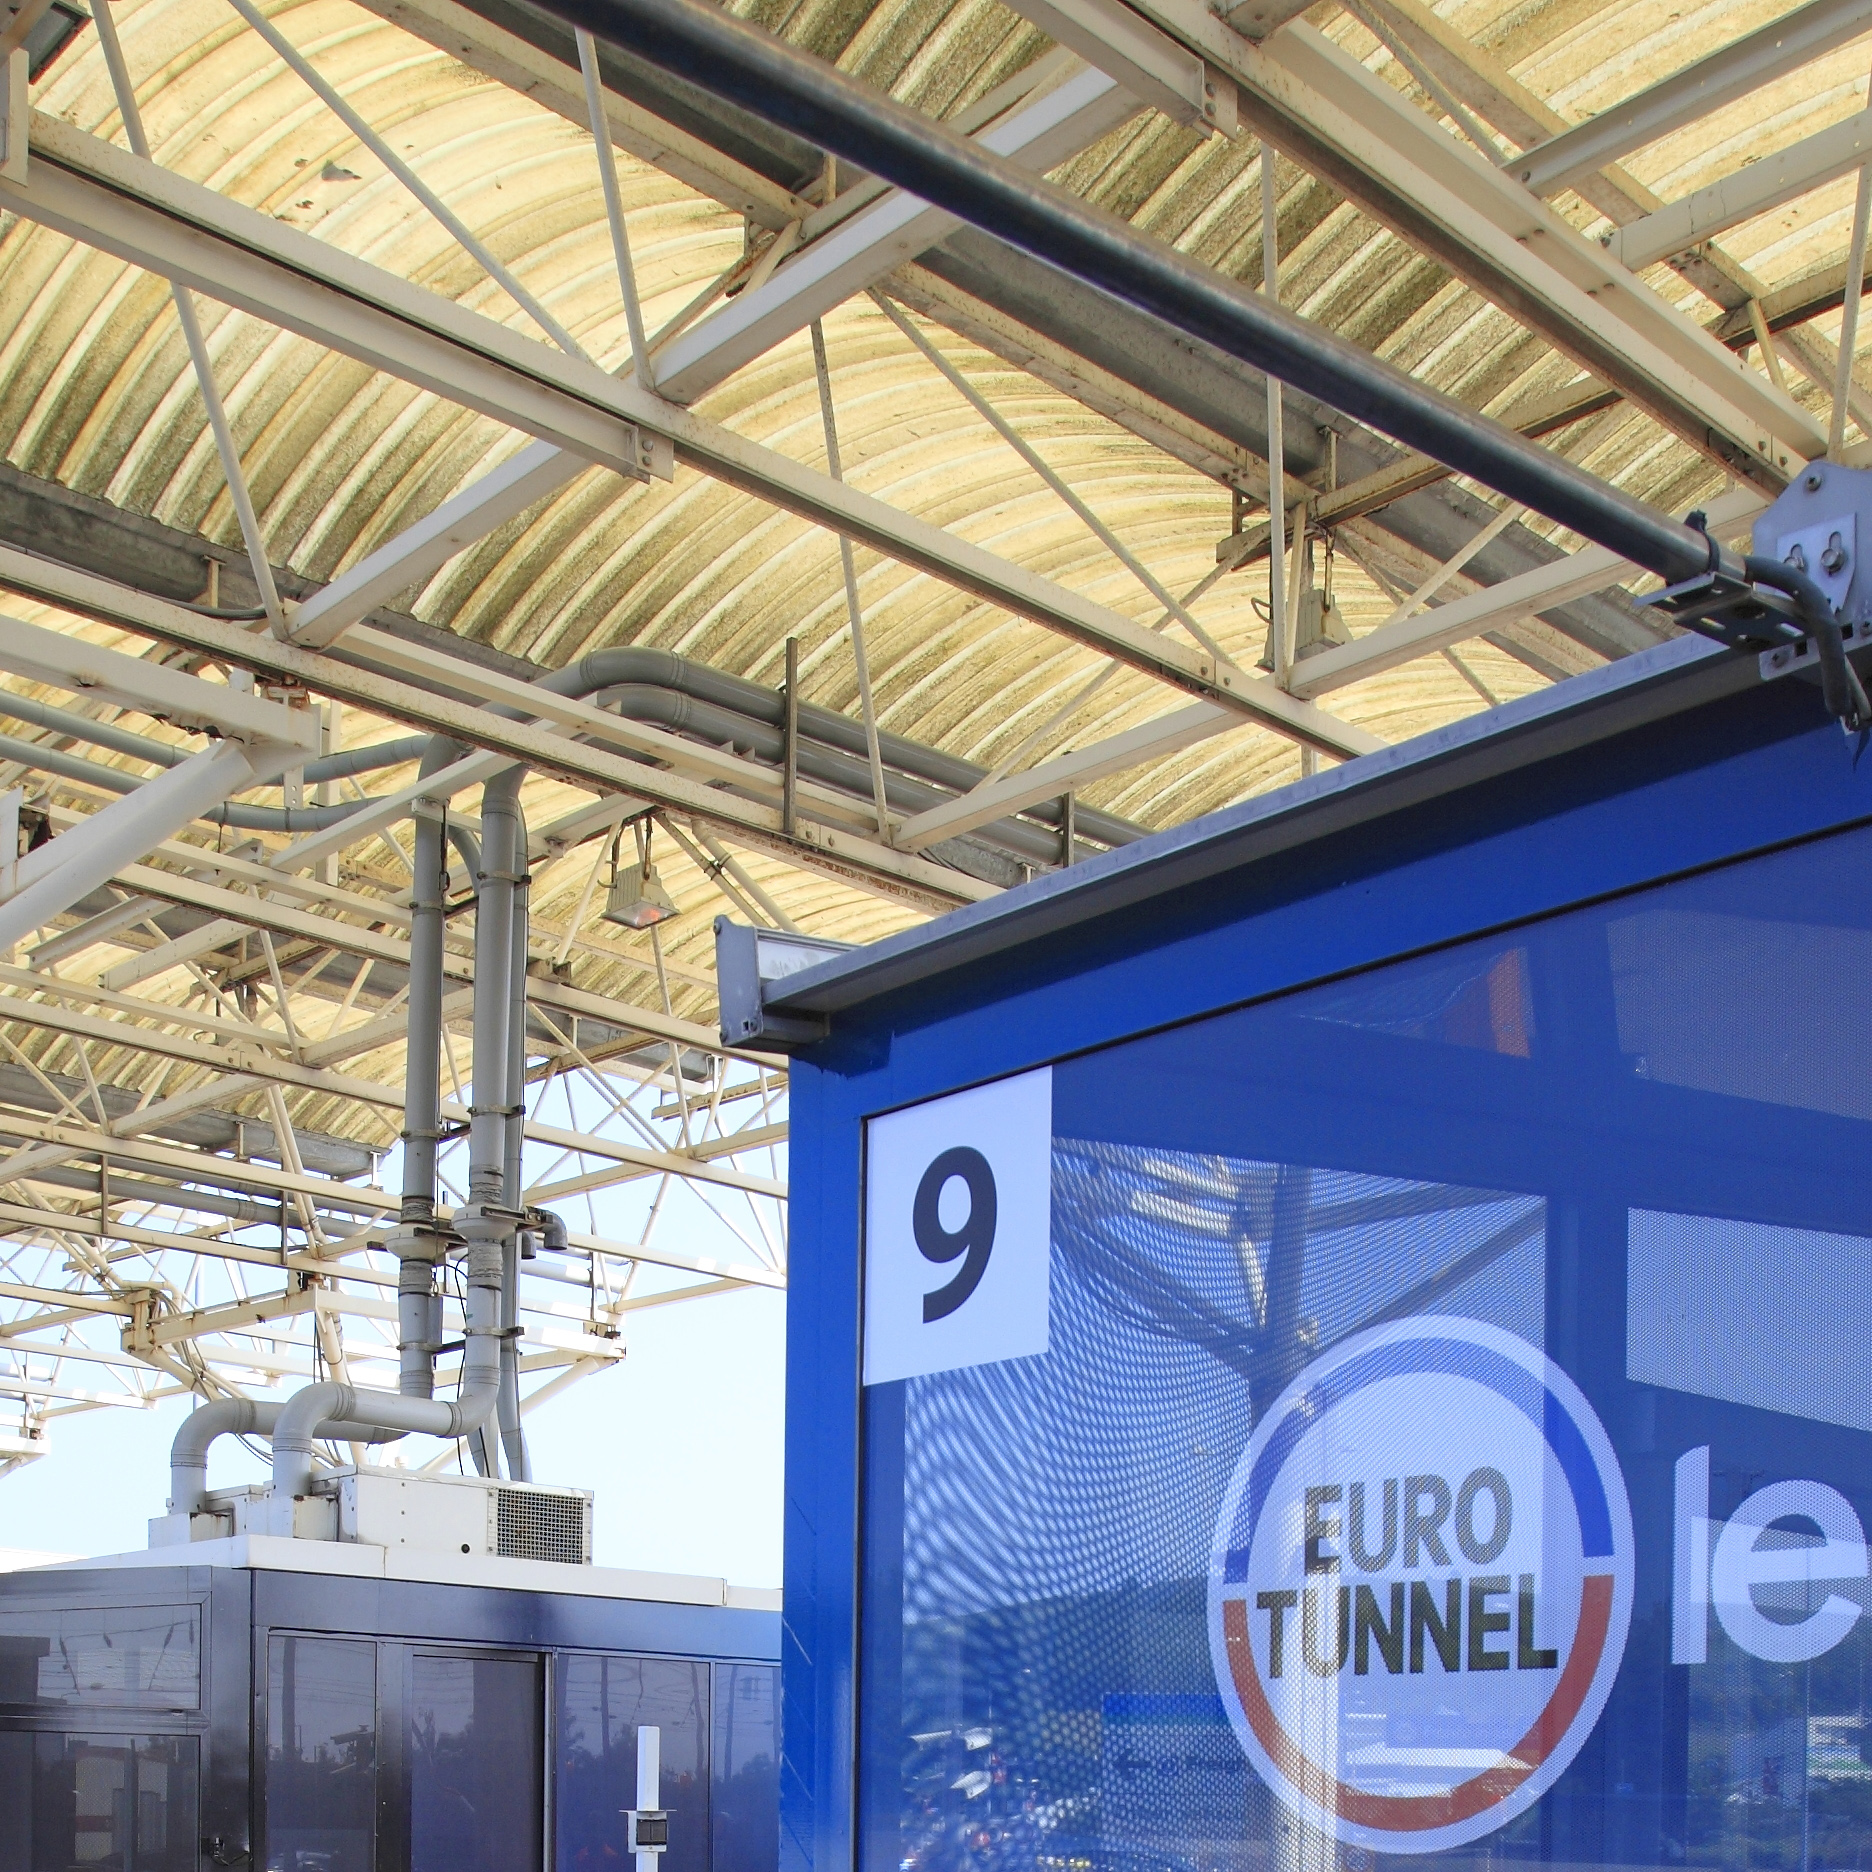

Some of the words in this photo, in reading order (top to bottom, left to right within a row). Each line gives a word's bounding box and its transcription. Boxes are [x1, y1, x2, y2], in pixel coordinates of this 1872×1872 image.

[912, 1146, 998, 1324] 9
[1304, 1466, 1513, 1576] EURO
[1671, 1444, 1869, 1665] le
[1257, 1574, 1558, 1679] TUNNEL
